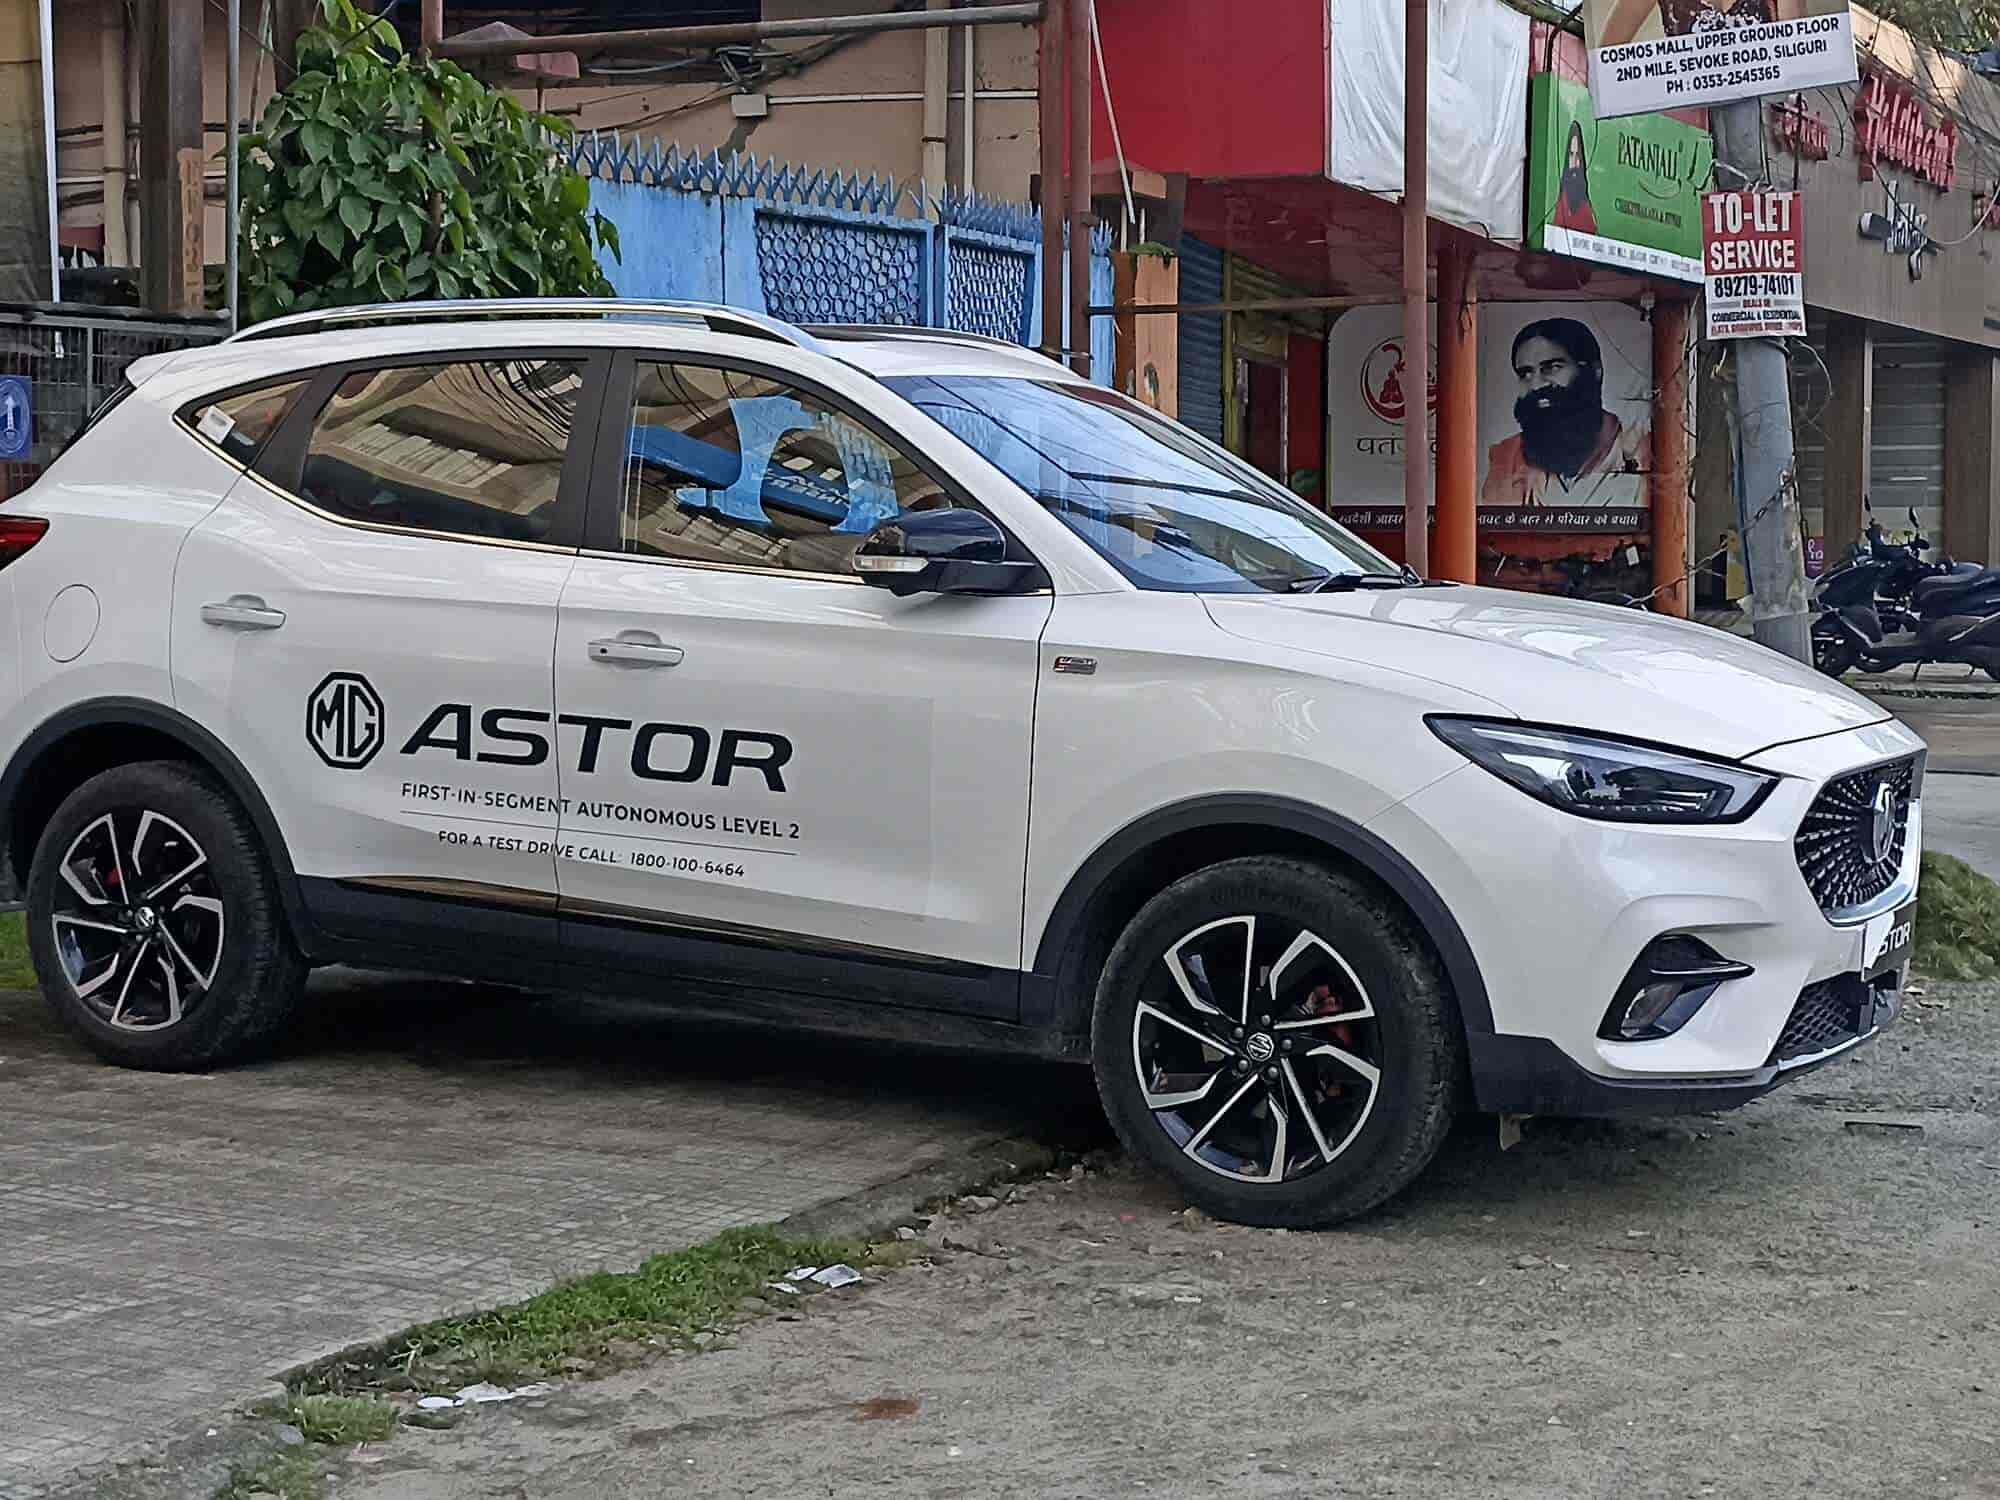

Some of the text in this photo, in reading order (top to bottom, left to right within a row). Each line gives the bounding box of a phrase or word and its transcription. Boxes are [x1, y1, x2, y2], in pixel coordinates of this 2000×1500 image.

[1600, 17, 1840, 64] COSMOS MALL, UPPER GROUND FLOOR
[1616, 39, 1828, 82] 2ND MILE, SEVOKE ROAD, SILIGURI
[1693, 65, 1781, 91] 0353-2545365
[1617, 132, 1678, 181] PATANJALI
[1709, 191, 1794, 233] TO-LET
[1710, 239, 1795, 271] SERVICE
[1714, 274, 1795, 298] 89279-74101
[311, 679, 380, 762] MG
[399, 703, 794, 793] ASTOR
[401, 782, 800, 839] FIRST-IN-SEGMENT AUTONOMOUS LEVEL 2
[438, 830, 469, 846] FOR
[473, 835, 483, 847] A
[489, 836, 523, 852] TEST
[527, 841, 574, 858] DRIVE
[630, 852, 745, 877] 1800-100-6464
